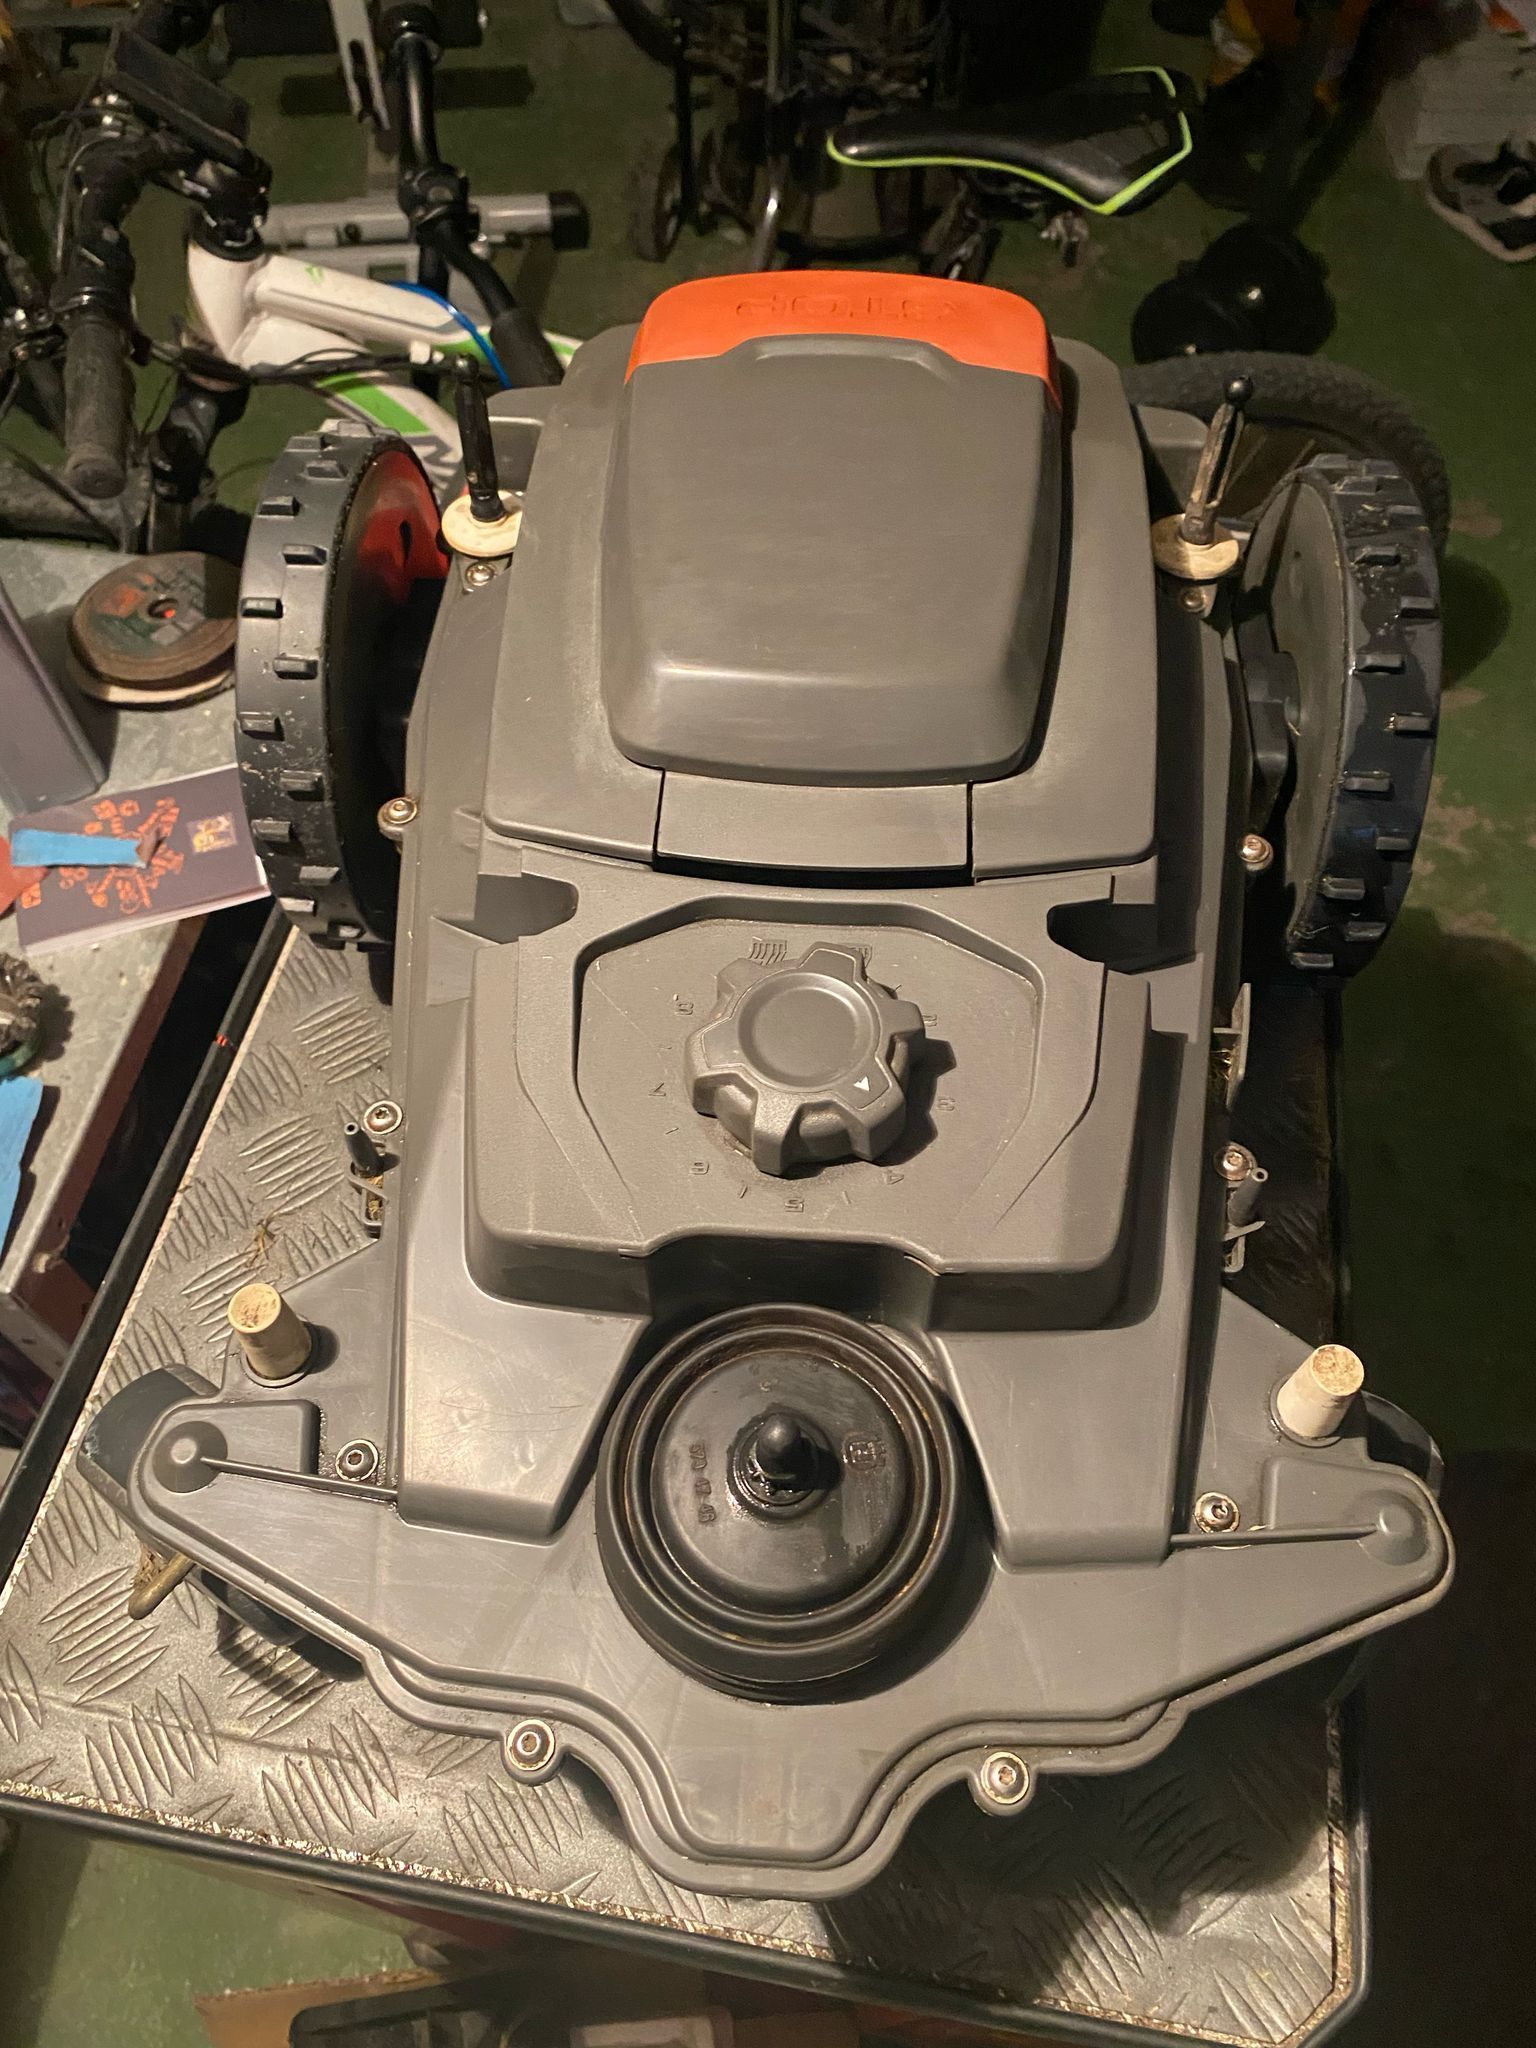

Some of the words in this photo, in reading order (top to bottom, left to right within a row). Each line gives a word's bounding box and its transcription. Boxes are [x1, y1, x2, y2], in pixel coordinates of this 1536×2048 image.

[648, 1082, 667, 1097] 7
[883, 1168, 905, 1184] 4
[784, 1199, 805, 1213] 5
